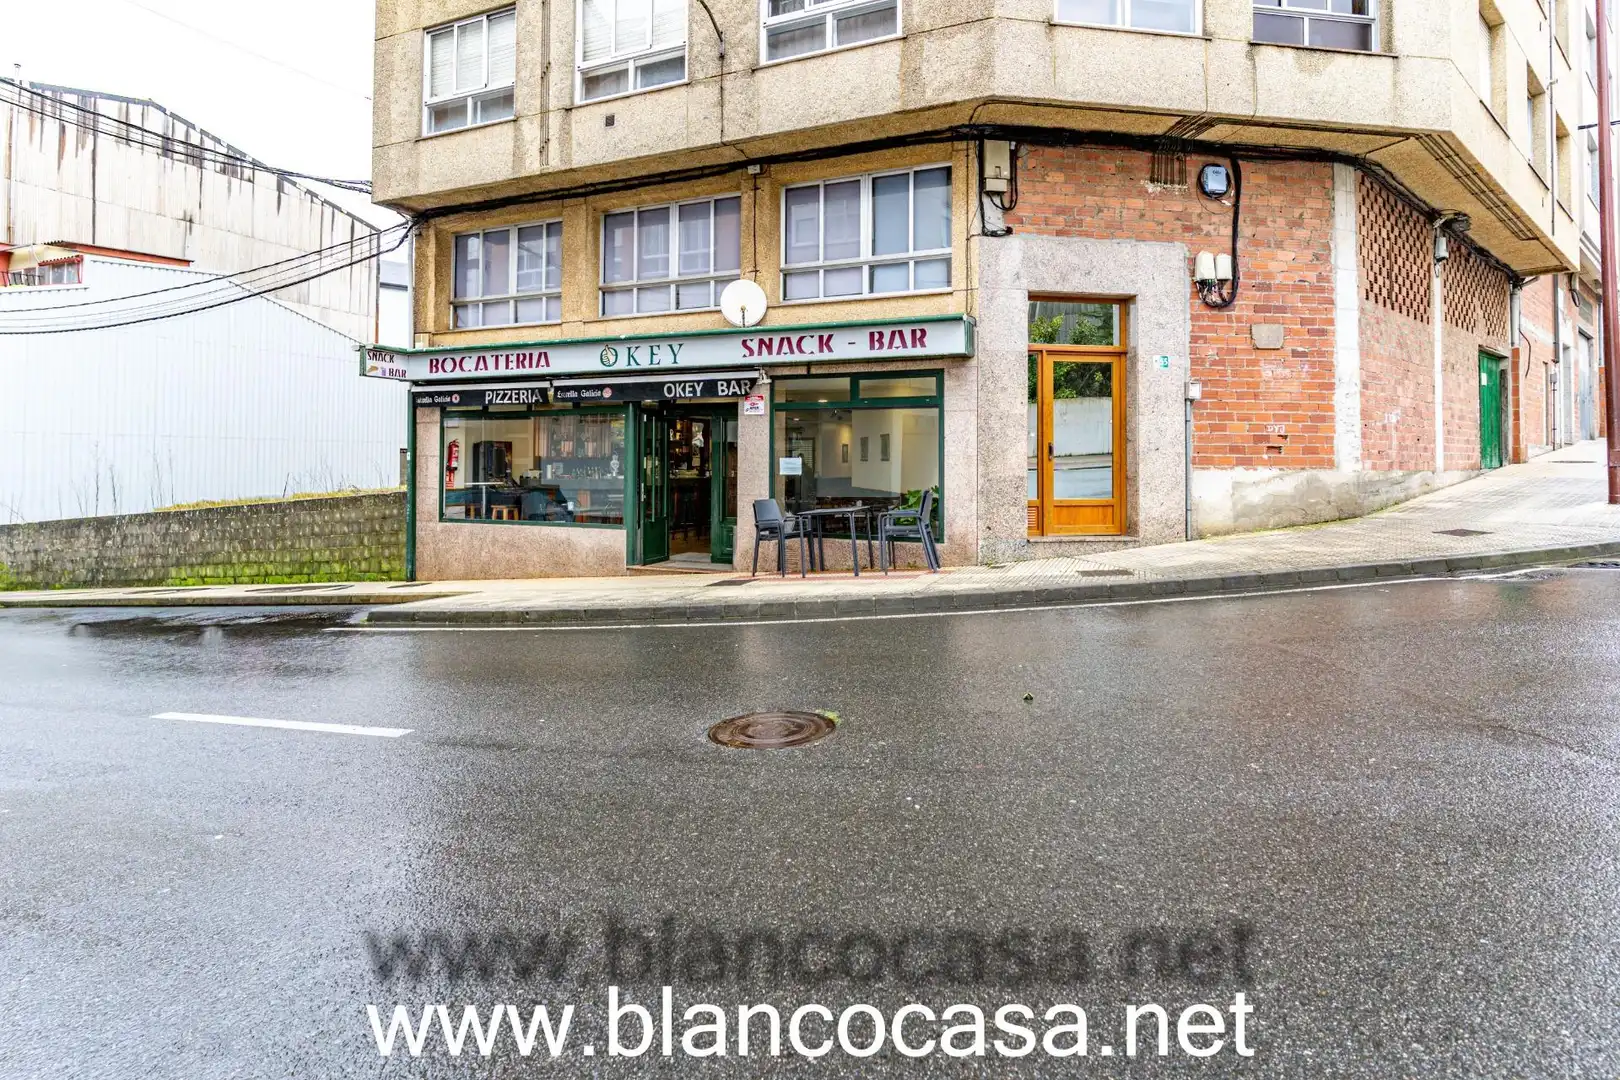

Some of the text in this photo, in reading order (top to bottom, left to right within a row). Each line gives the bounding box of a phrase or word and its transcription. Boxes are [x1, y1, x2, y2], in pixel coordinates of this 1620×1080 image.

[741, 333, 834, 358] SNACK
[868, 328, 927, 351] BAR
[367, 350, 395, 363] SNACK
[428, 351, 551, 374] BOCATERIA
[600, 343, 685, 368] OKEY
[388, 368, 407, 378] BAR
[485, 389, 543, 404] PIZZERIA
[663, 380, 751, 398] OKEY BAR
